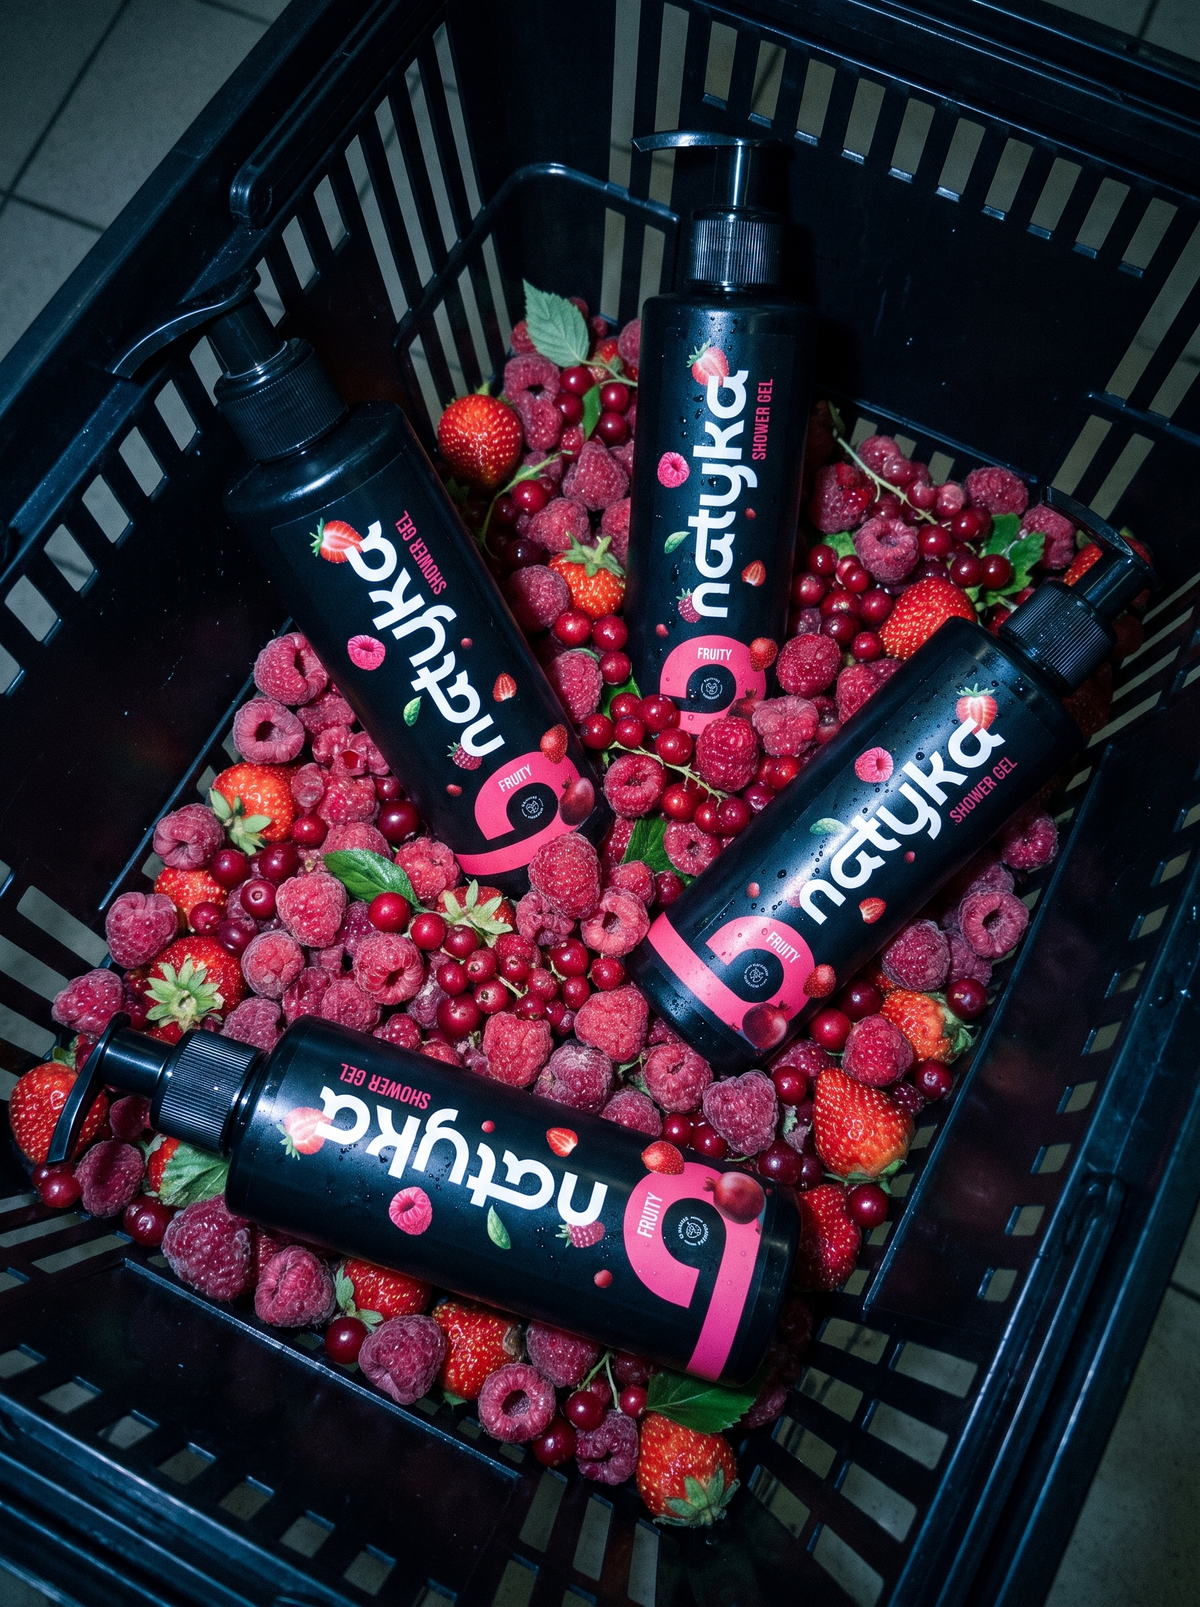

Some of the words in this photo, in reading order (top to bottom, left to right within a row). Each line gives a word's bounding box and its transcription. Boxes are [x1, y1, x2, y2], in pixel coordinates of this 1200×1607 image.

[757, 378, 774, 403] GEL
[751, 404, 770, 460] SHOWER
[688, 369, 758, 618] natyka
[395, 510, 418, 542] GEL
[408, 542, 447, 595] SHOWER
[343, 520, 506, 757] natyka
[697, 646, 732, 661] FRUITY
[497, 763, 532, 792] FRUITY
[949, 775, 997, 824] SHOWER
[992, 757, 1018, 780] GEL
[799, 716, 1006, 925] natyka
[765, 930, 801, 964] FRUITY
[339, 1062, 367, 1086] GEL
[367, 1074, 429, 1109] SHOWER
[313, 1085, 608, 1227] natyka
[636, 1191, 663, 1238] FRUITY
